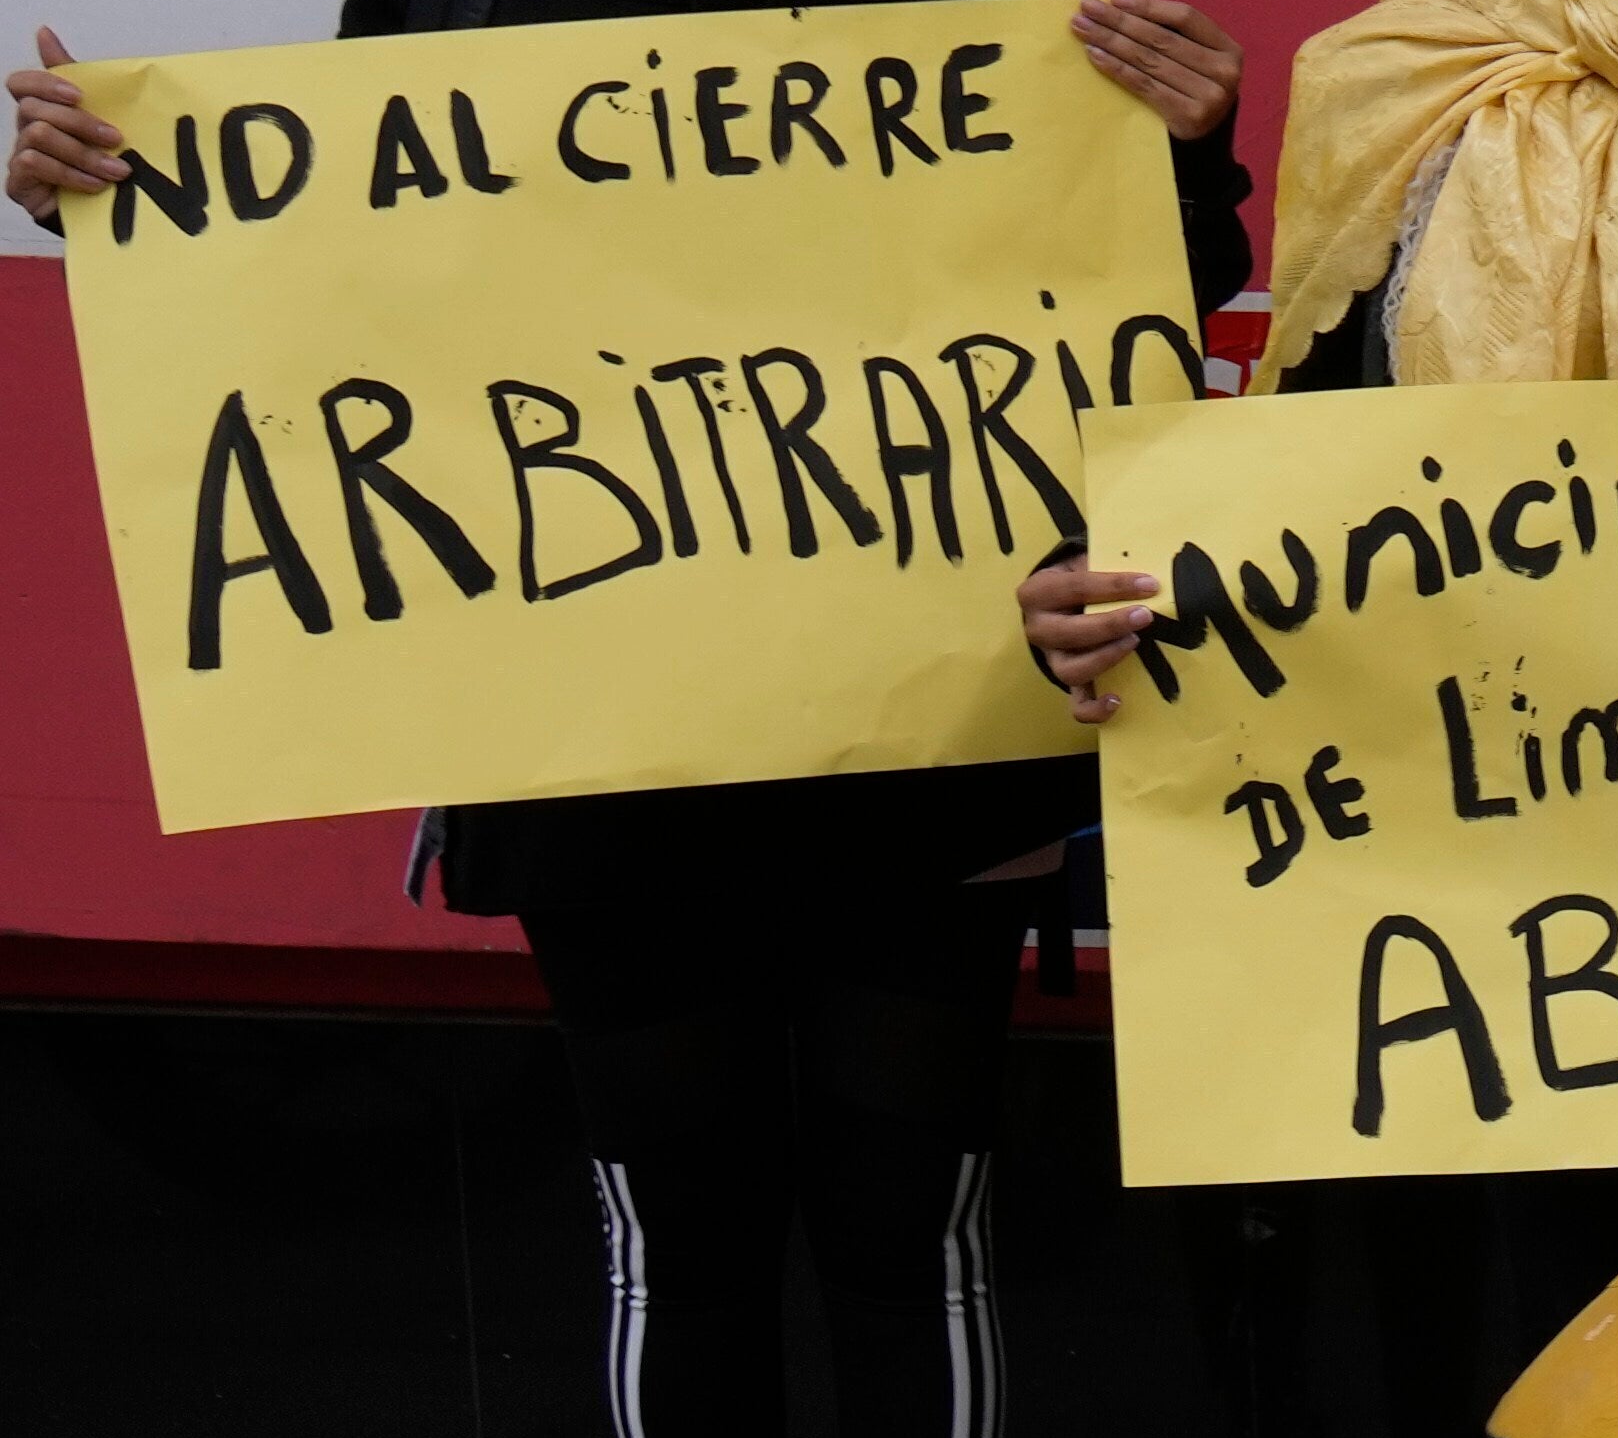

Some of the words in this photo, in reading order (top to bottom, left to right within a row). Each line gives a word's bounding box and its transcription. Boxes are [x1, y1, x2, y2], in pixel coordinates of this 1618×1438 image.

[111, 102, 312, 246] NO
[368, 87, 518, 210] AL
[1224, 744, 1375, 888] DE
